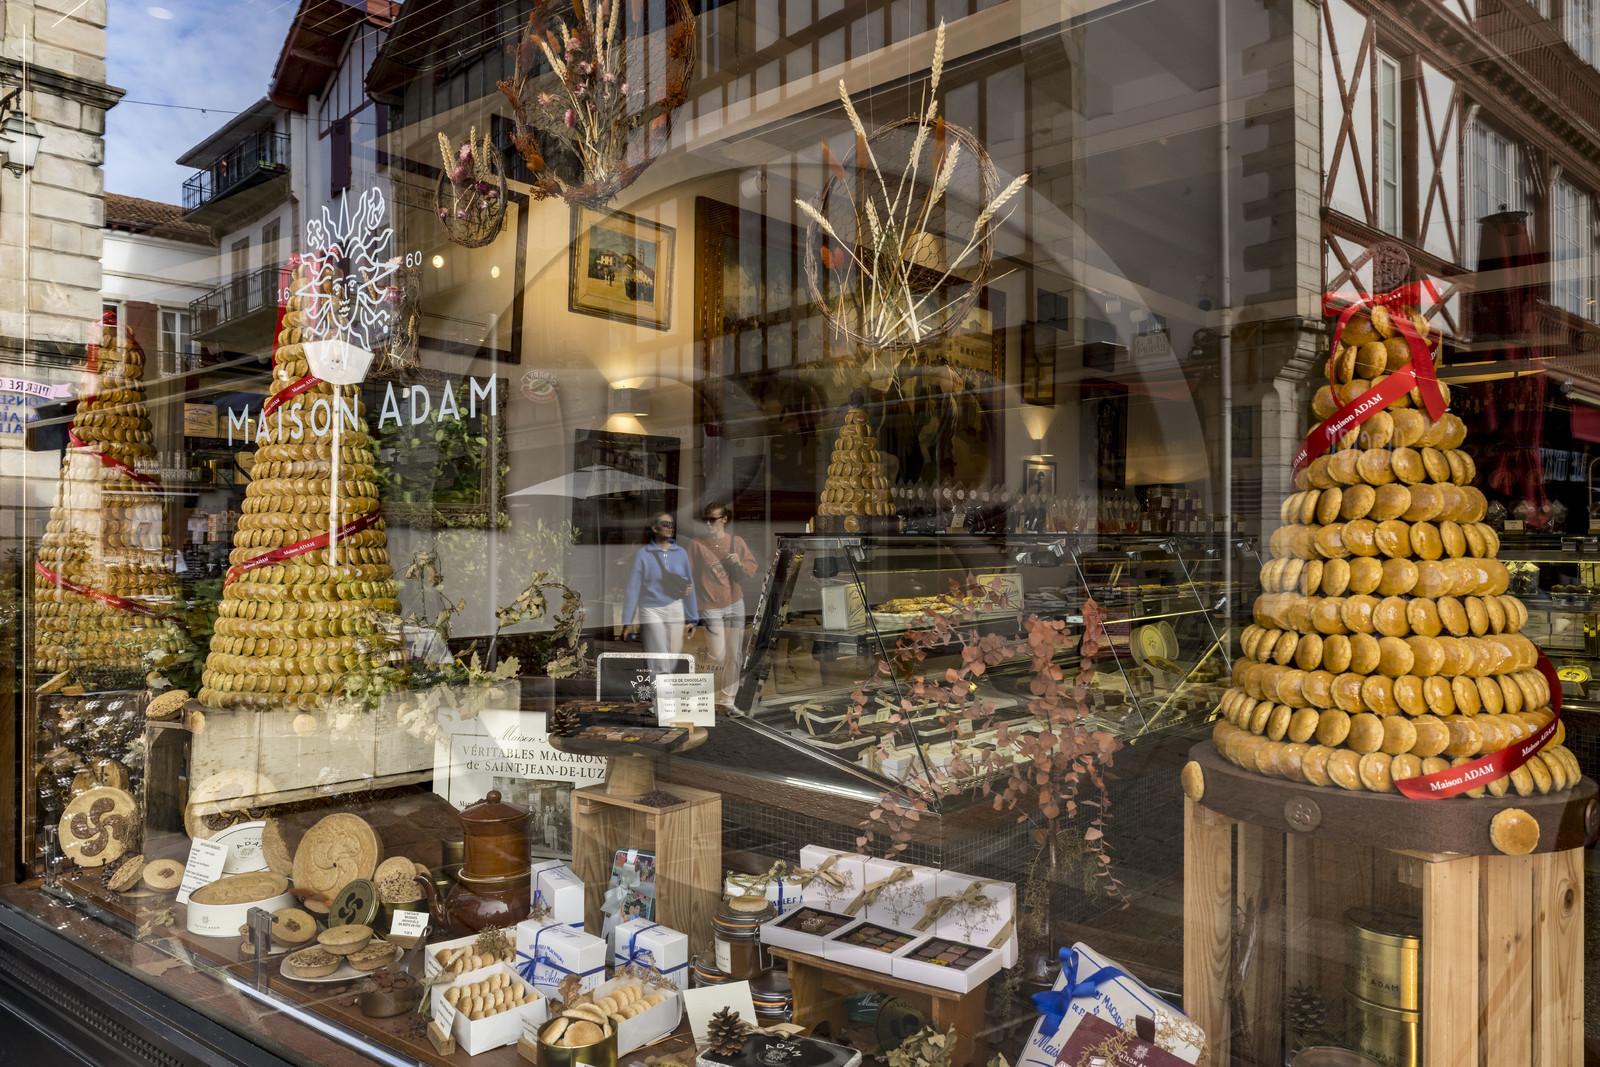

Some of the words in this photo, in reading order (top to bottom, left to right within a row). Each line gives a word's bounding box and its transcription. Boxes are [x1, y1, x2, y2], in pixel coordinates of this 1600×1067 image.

[277, 287, 290, 302] 16
[405, 250, 422, 268] 60
[228, 394, 359, 447] MAISON
[378, 372, 497, 429] ADAM
[1327, 413, 1355, 435] Maison
[1353, 393, 1383, 417] ADAM
[299, 541, 315, 550] ADAM
[494, 725, 536, 743] Maison
[1521, 739, 1540, 757] Maison
[1539, 722, 1556, 741] ADAM
[462, 743, 535, 760] VÉRITABLES
[539, 750, 608, 765] MACARONS
[466, 759, 480, 770] de
[484, 762, 605, 780] SAINT-JEAN-DE-LUZ
[1429, 776, 1463, 792] Maison
[1463, 762, 1495, 782] ADAM
[1370, 978, 1400, 992] ADAM
[765, 1043, 803, 1057] ADAM
